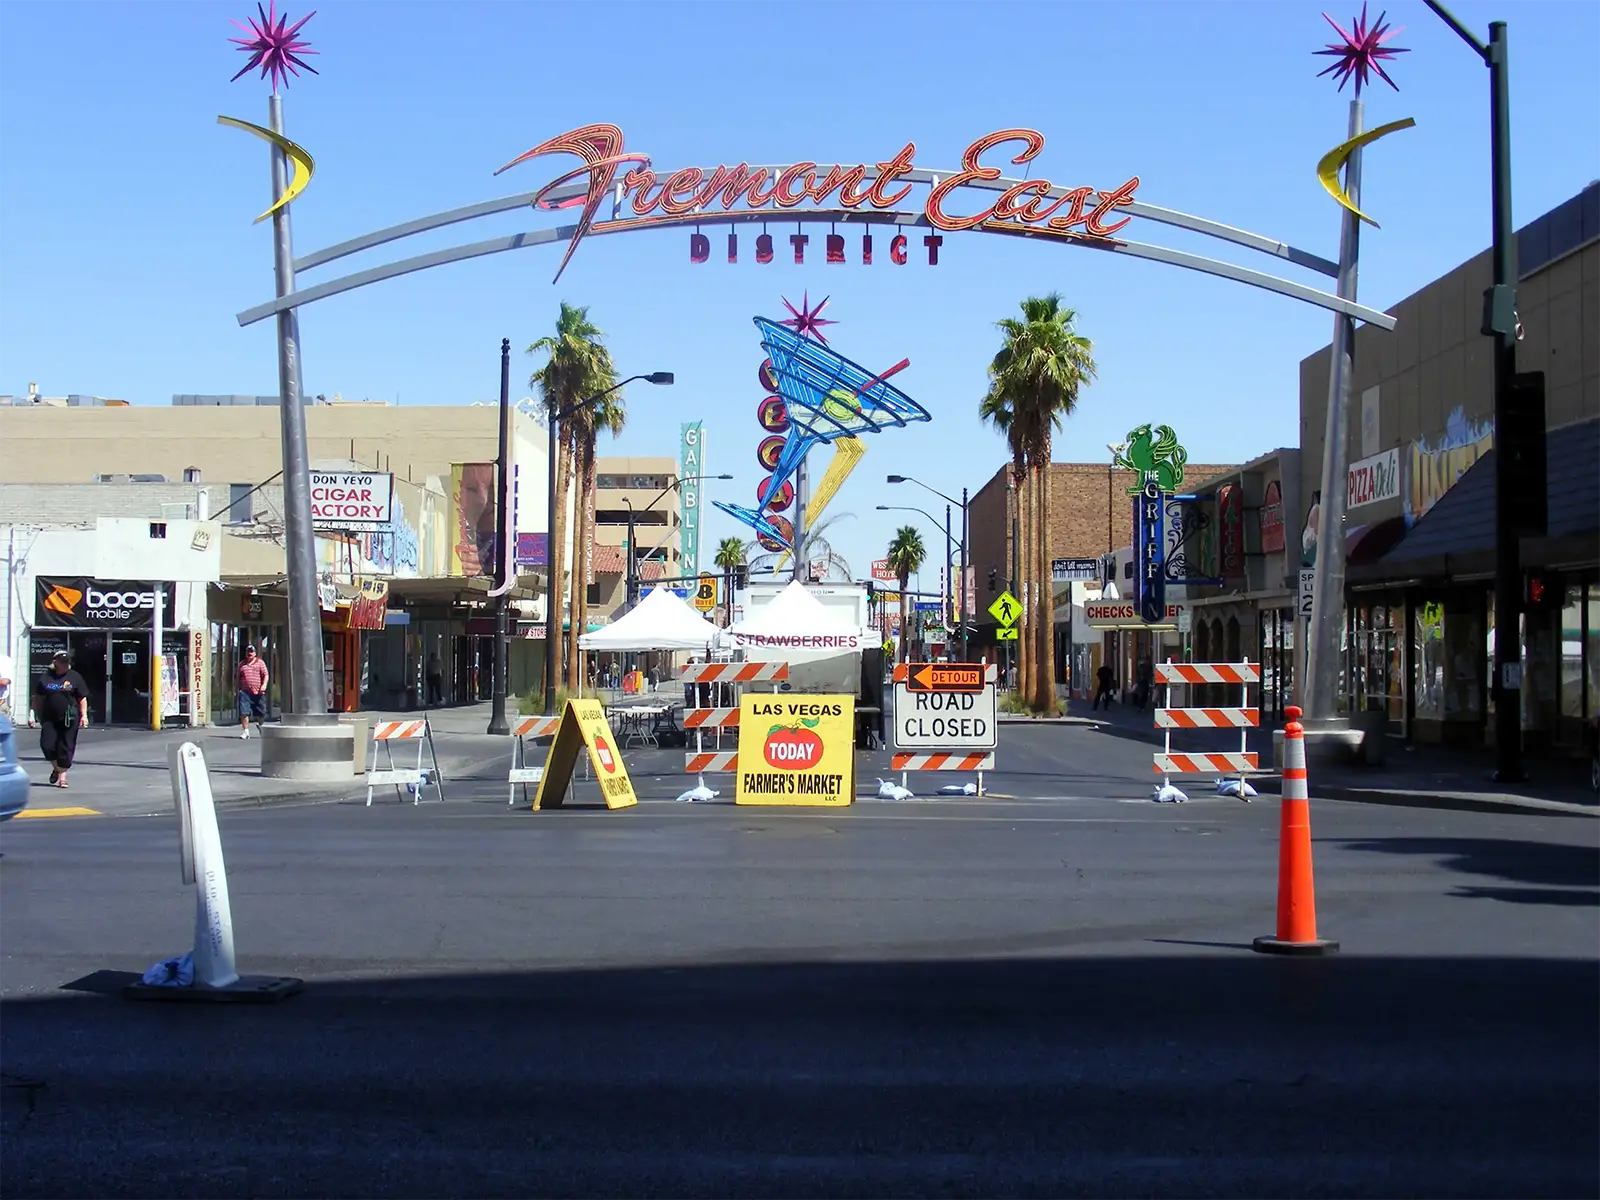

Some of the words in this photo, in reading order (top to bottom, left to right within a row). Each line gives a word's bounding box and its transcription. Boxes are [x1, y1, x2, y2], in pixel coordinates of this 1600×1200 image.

[493, 122, 917, 285] Fremont
[925, 128, 1141, 236] East
[690, 234, 944, 266] DISTRICT
[313, 475, 337, 484] DON
[343, 475, 372, 485] YEYO
[1144, 470, 1159, 481] THE
[1349, 466, 1375, 506] PIZZA
[312, 488, 372, 502] CIGAR
[311, 504, 384, 518] ACTORY
[683, 429, 698, 590] GAMBLING
[1145, 483, 1159, 619] GRIFFIN
[697, 584, 713, 599] 8
[86, 609, 130, 619] mobile
[1087, 605, 1133, 619] CHECKS
[194, 632, 202, 661] CHEK
[735, 634, 857, 648] STRAWBERRIES
[932, 672, 977, 682] DETOUR
[916, 692, 974, 710] ROAD
[753, 704, 783, 715] LAS
[788, 704, 842, 716] VEGAS
[905, 718, 986, 737] CLOSED
[769, 742, 815, 760] TODAY
[743, 773, 795, 794] FARMER'S
[797, 774, 842, 794] MARKET
